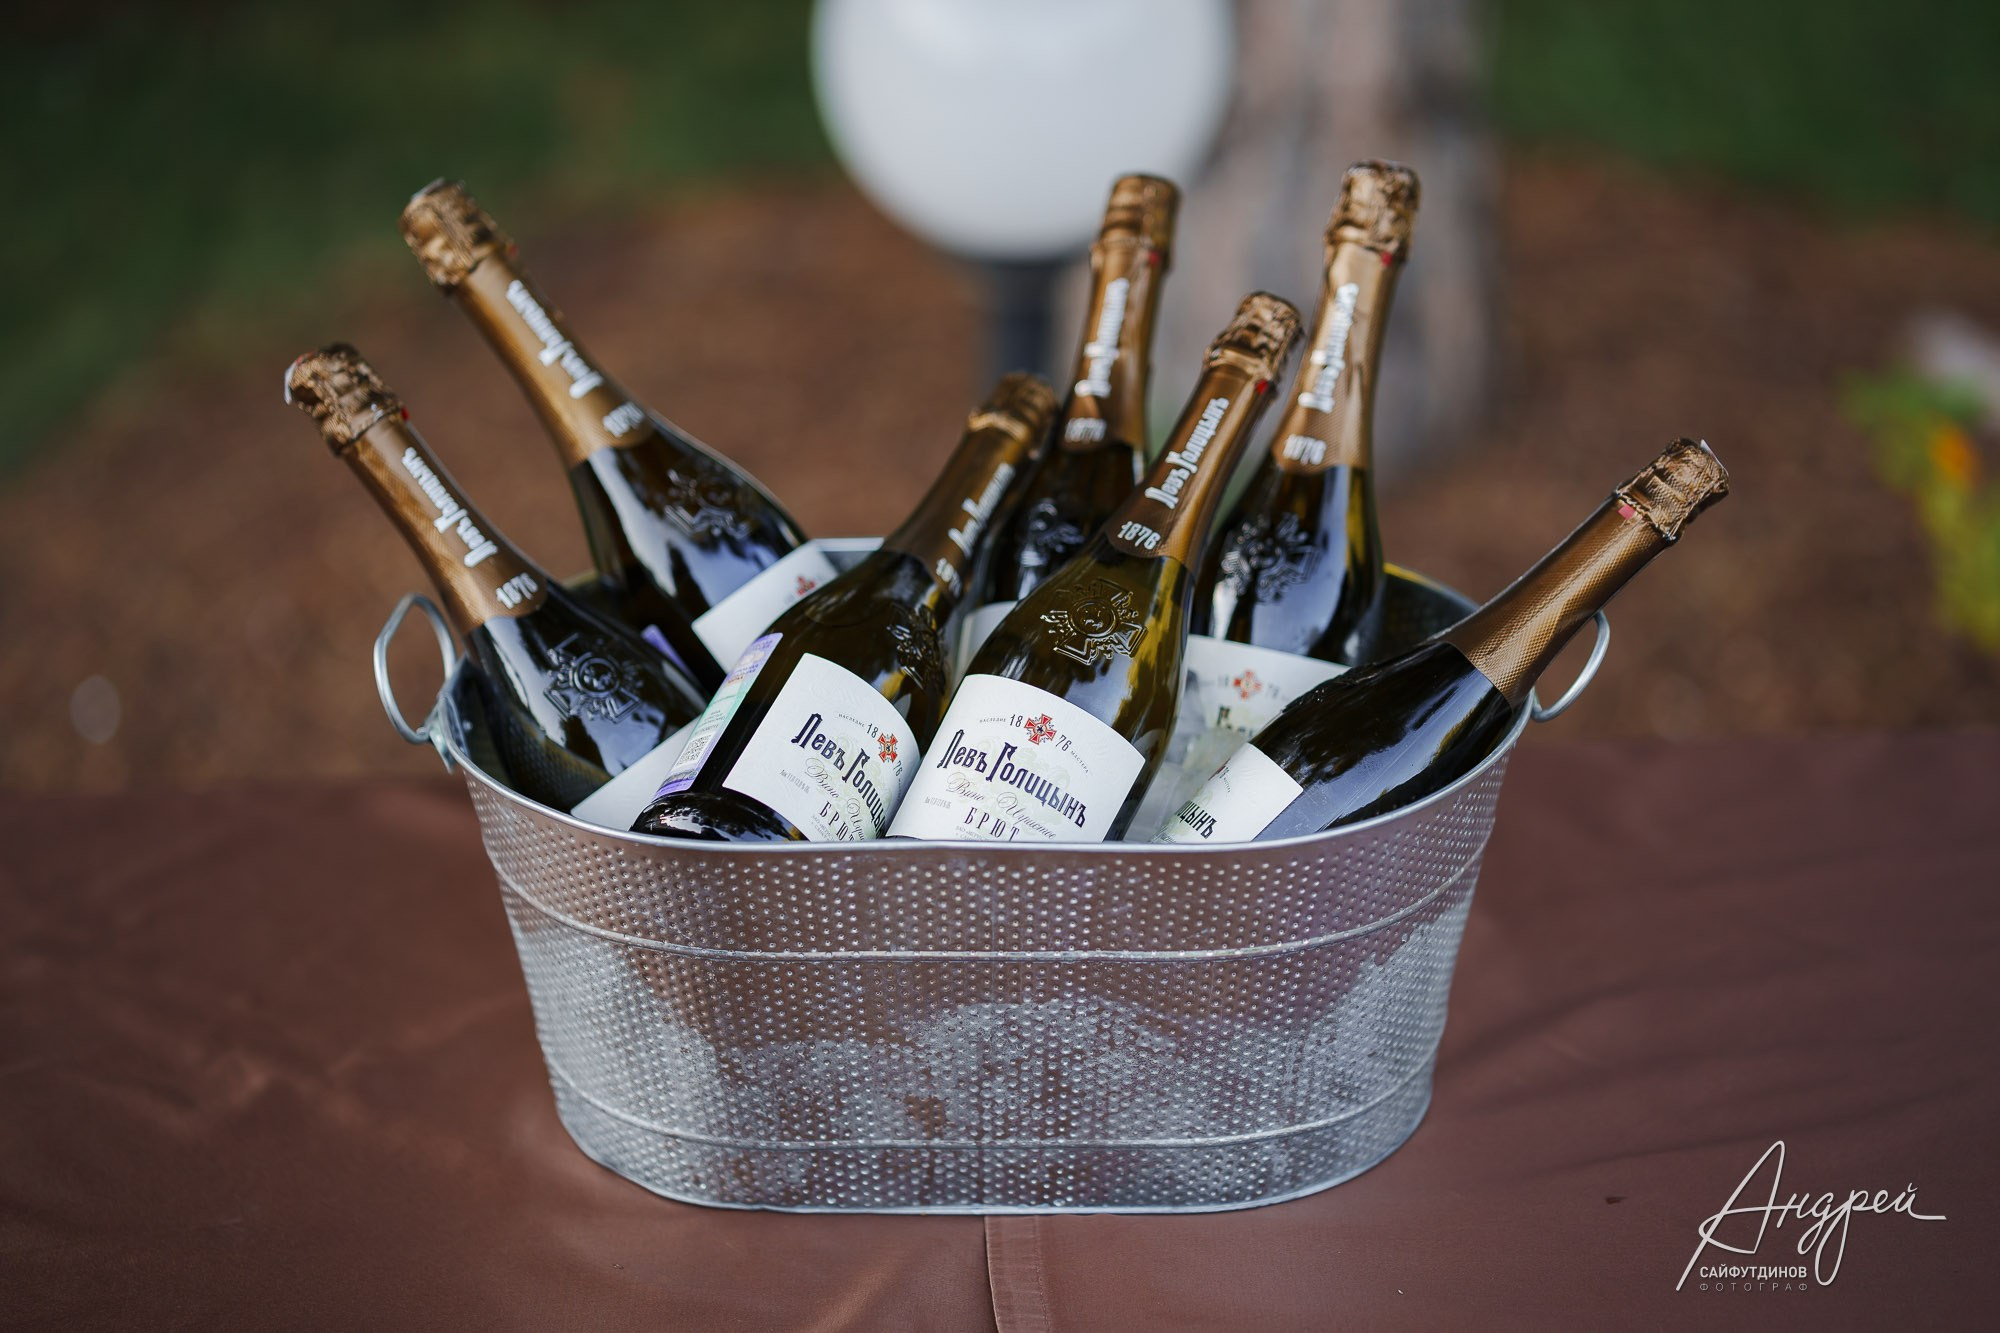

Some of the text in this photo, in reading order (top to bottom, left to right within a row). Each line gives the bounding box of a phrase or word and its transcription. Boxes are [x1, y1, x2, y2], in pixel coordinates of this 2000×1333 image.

[1145, 397, 1229, 509] Левъ Голицынъ
[1117, 520, 1161, 550] 1876
[790, 712, 846, 771] Левъ
[866, 722, 879, 739] 18
[1009, 713, 1023, 728] 18
[1055, 734, 1072, 752] 76
[1070, 750, 1089, 774] МАСТЕРА
[936, 728, 1086, 829] Левъ Голицынъ
[963, 806, 1020, 842] БРЮТ
